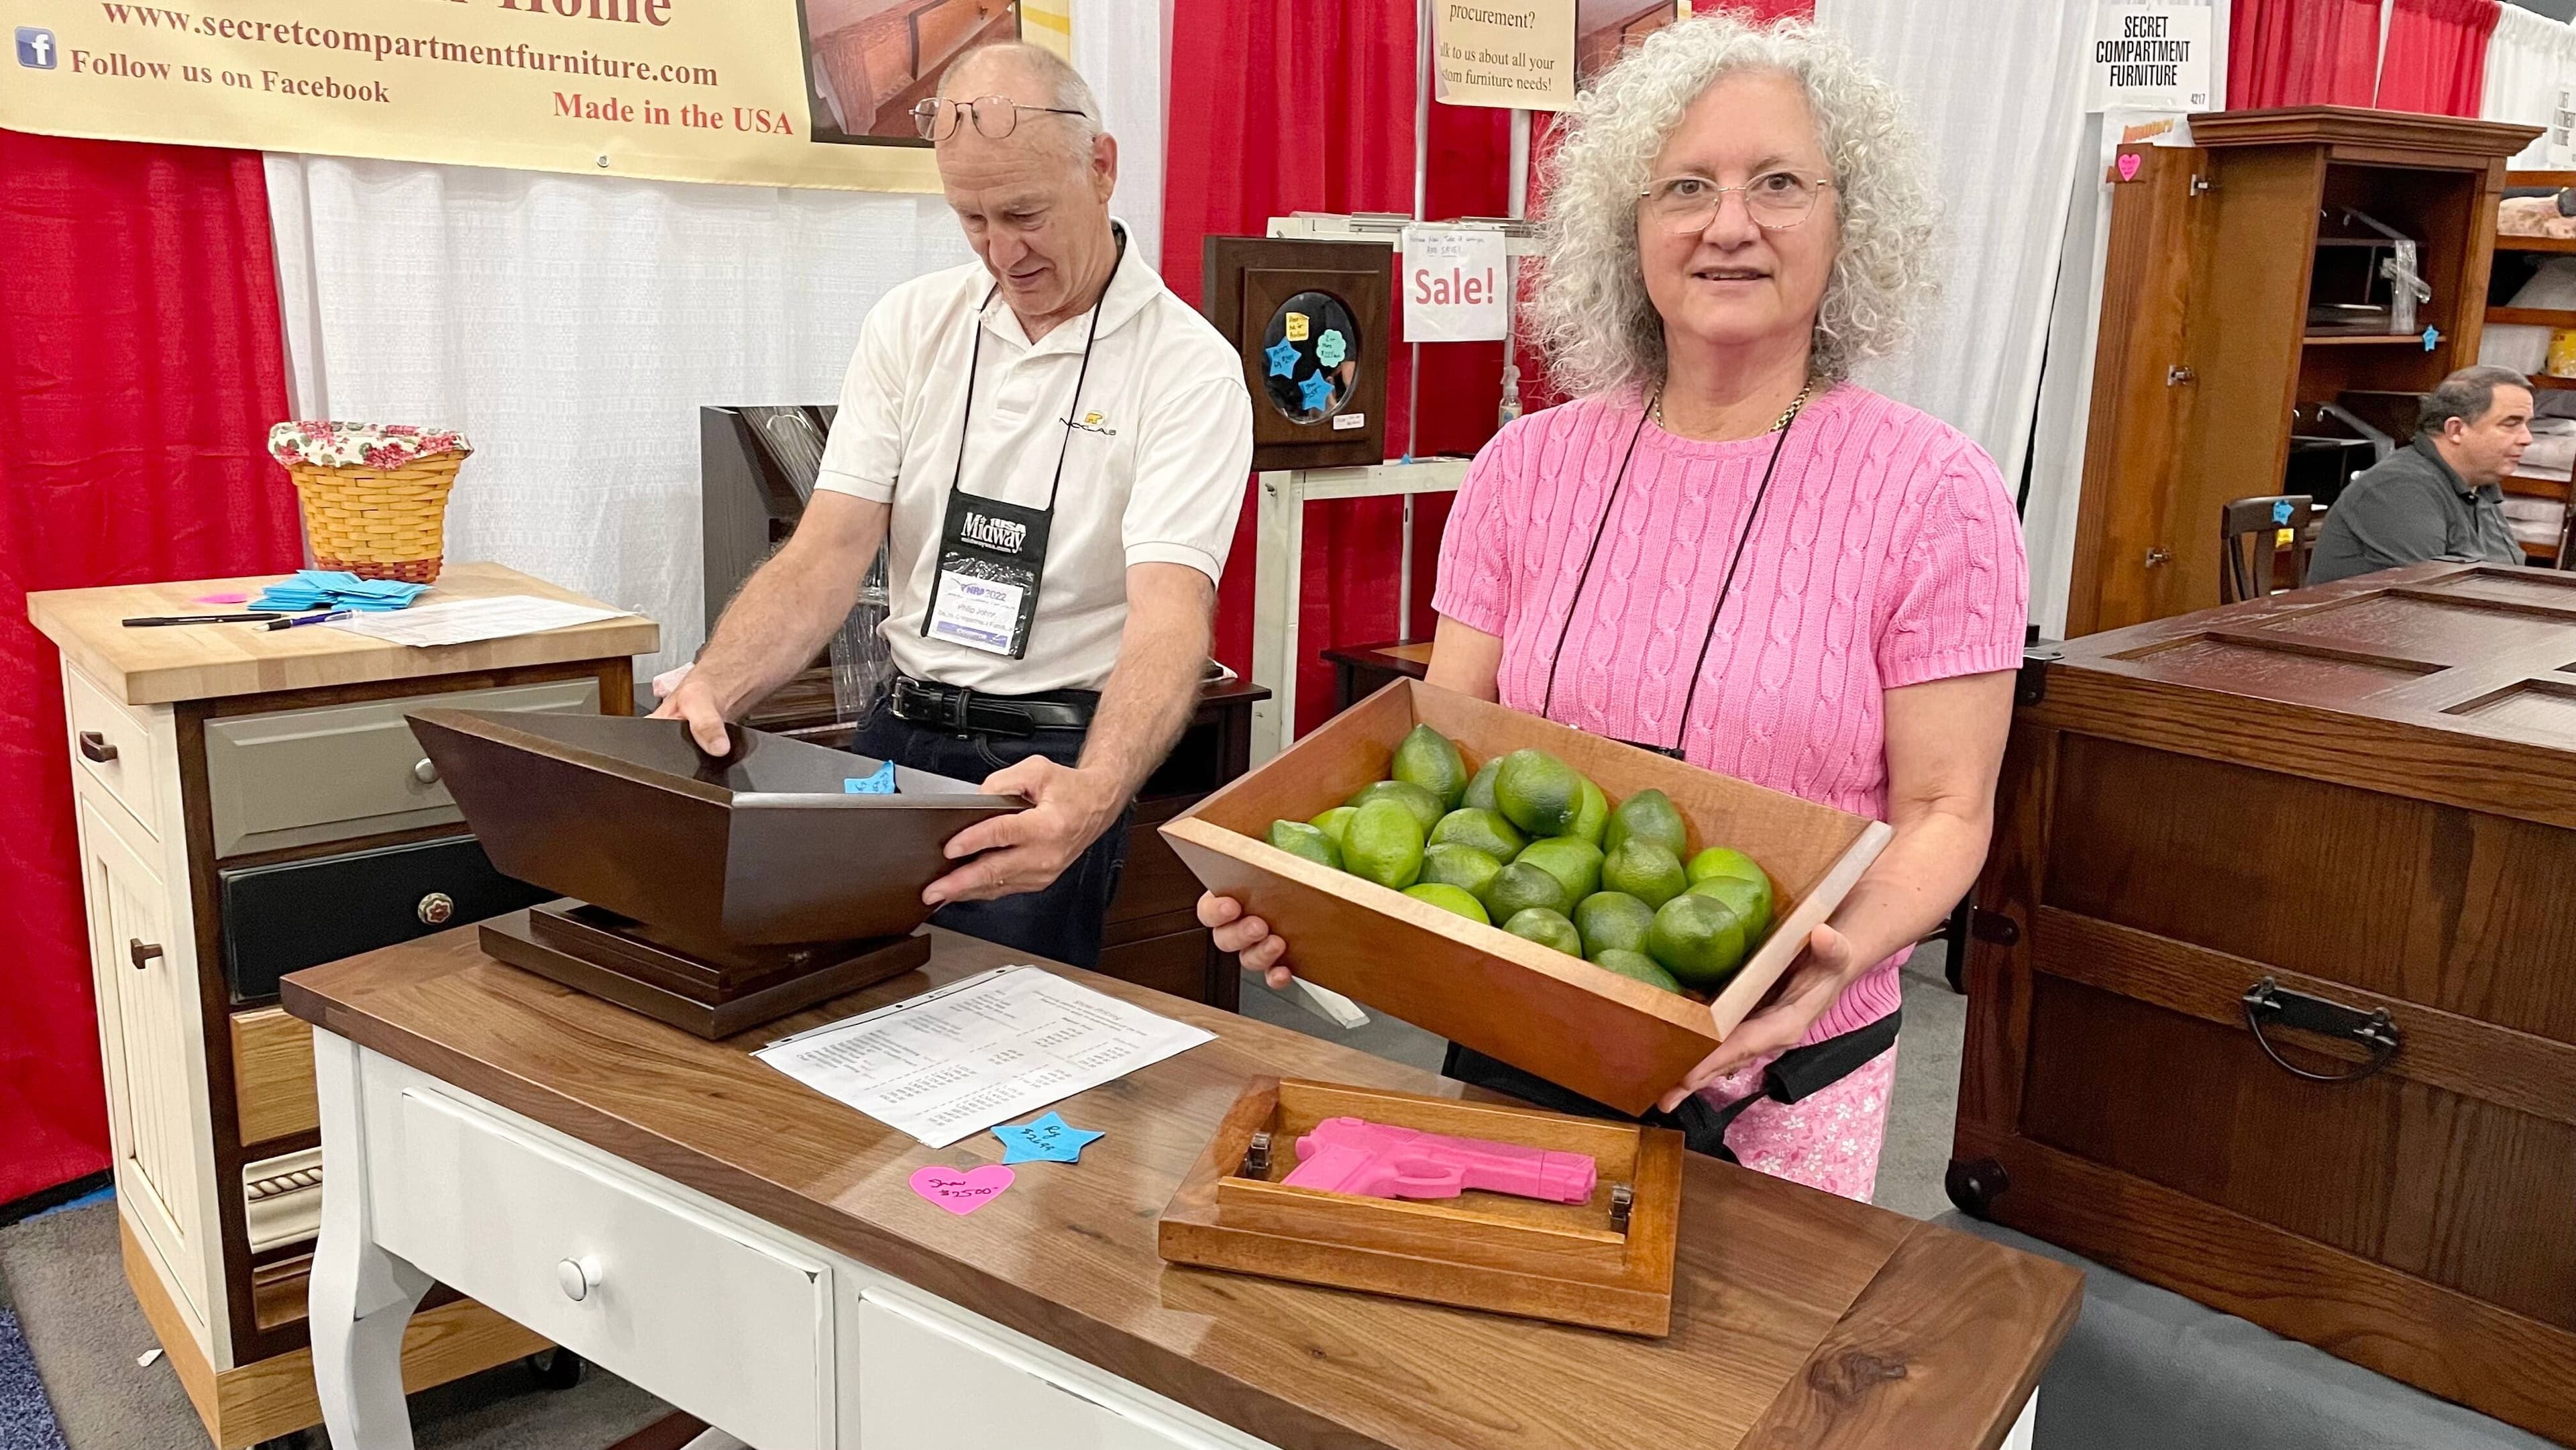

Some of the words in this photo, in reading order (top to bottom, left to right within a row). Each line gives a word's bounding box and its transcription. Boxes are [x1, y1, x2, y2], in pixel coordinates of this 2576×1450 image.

[1450, 4, 1536, 29] procurement?
[2124, 15, 2169, 38] SECRET
[101, 2, 718, 87] www.secretcompartmentfurniture.com
[2096, 40, 2191, 63] COMPARTMENT
[1452, 46, 1462, 60] to
[1464, 49, 1476, 62] us
[1479, 48, 1509, 65] about
[1512, 52, 1525, 67] all
[1529, 56, 1555, 72] your
[69, 50, 172, 81] Follow
[182, 64, 213, 85] us
[221, 71, 253, 90] on
[262, 70, 390, 103] Facebook
[1465, 69, 1513, 88] furniture
[1516, 76, 1552, 92] needs!
[2110, 64, 2178, 87] FURNITURE
[2190, 93, 2206, 105] 4217
[553, 92, 634, 123] Made
[644, 99, 671, 126] in
[680, 104, 724, 130] the
[733, 107, 794, 136] USA
[1415, 267, 1493, 305] Sale!
[961, 512, 1026, 554] Midway
